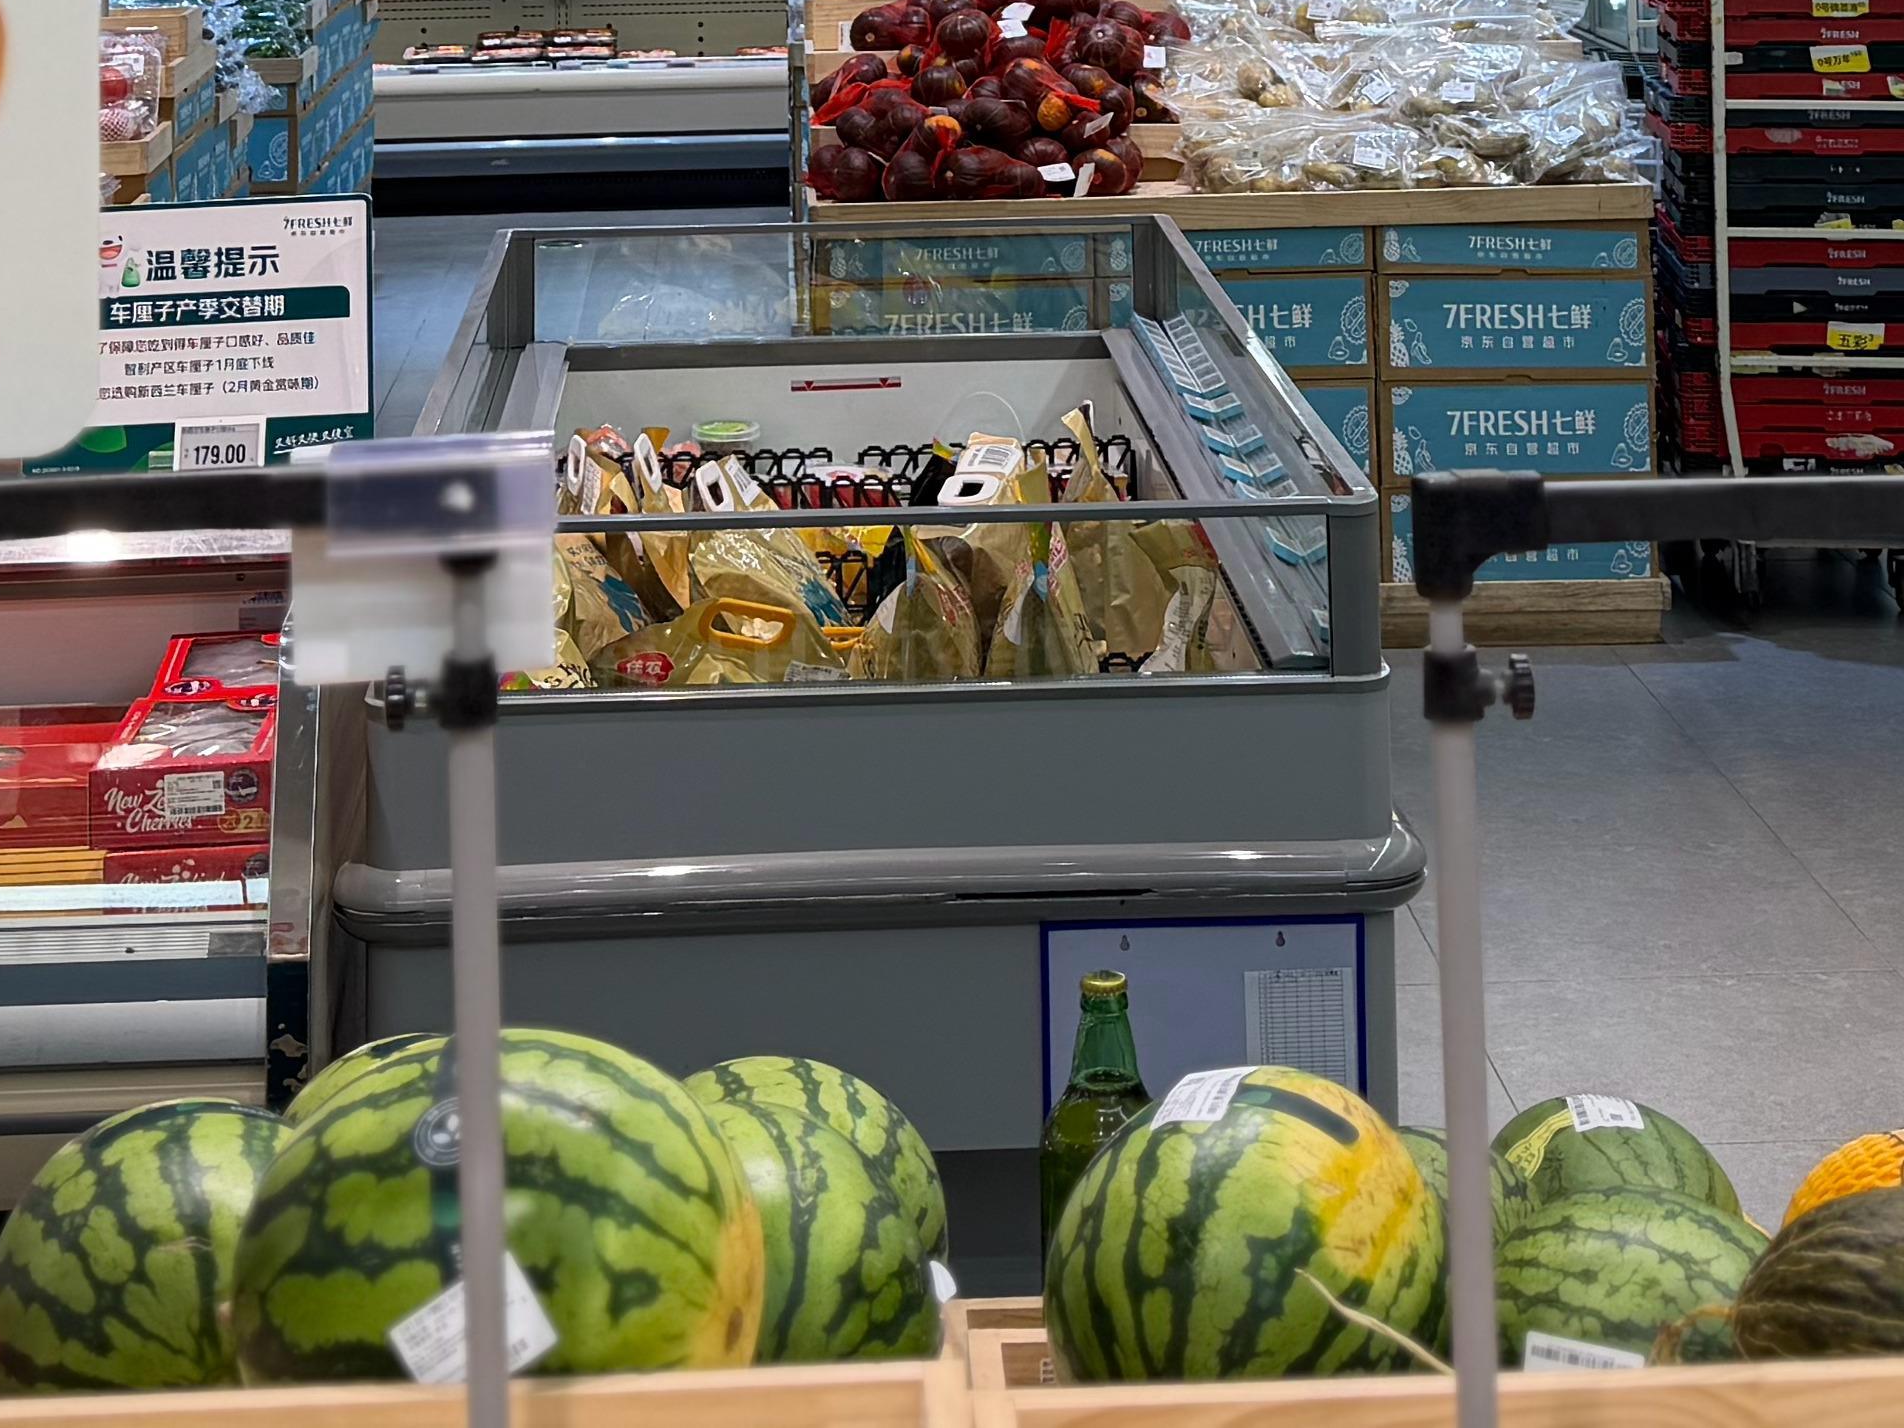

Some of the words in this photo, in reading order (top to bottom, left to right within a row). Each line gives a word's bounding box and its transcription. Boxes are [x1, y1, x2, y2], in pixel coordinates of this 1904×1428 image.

[1195, 238, 1279, 254] 7FRESH七鲜
[1468, 235, 1553, 252] 7FRESH七鲜
[146, 245, 280, 282] 温馨提示
[109, 295, 286, 325] 车厘子产季交替期
[1442, 303, 1593, 331] 7FRESH七鲜
[1460, 335, 1576, 349] 京东自营超市
[1446, 409, 1597, 437] 7FRESH七鲜
[193, 443, 246, 465] 179.00
[1464, 442, 1581, 456] 京东自营超市
[104, 787, 144, 812] New
